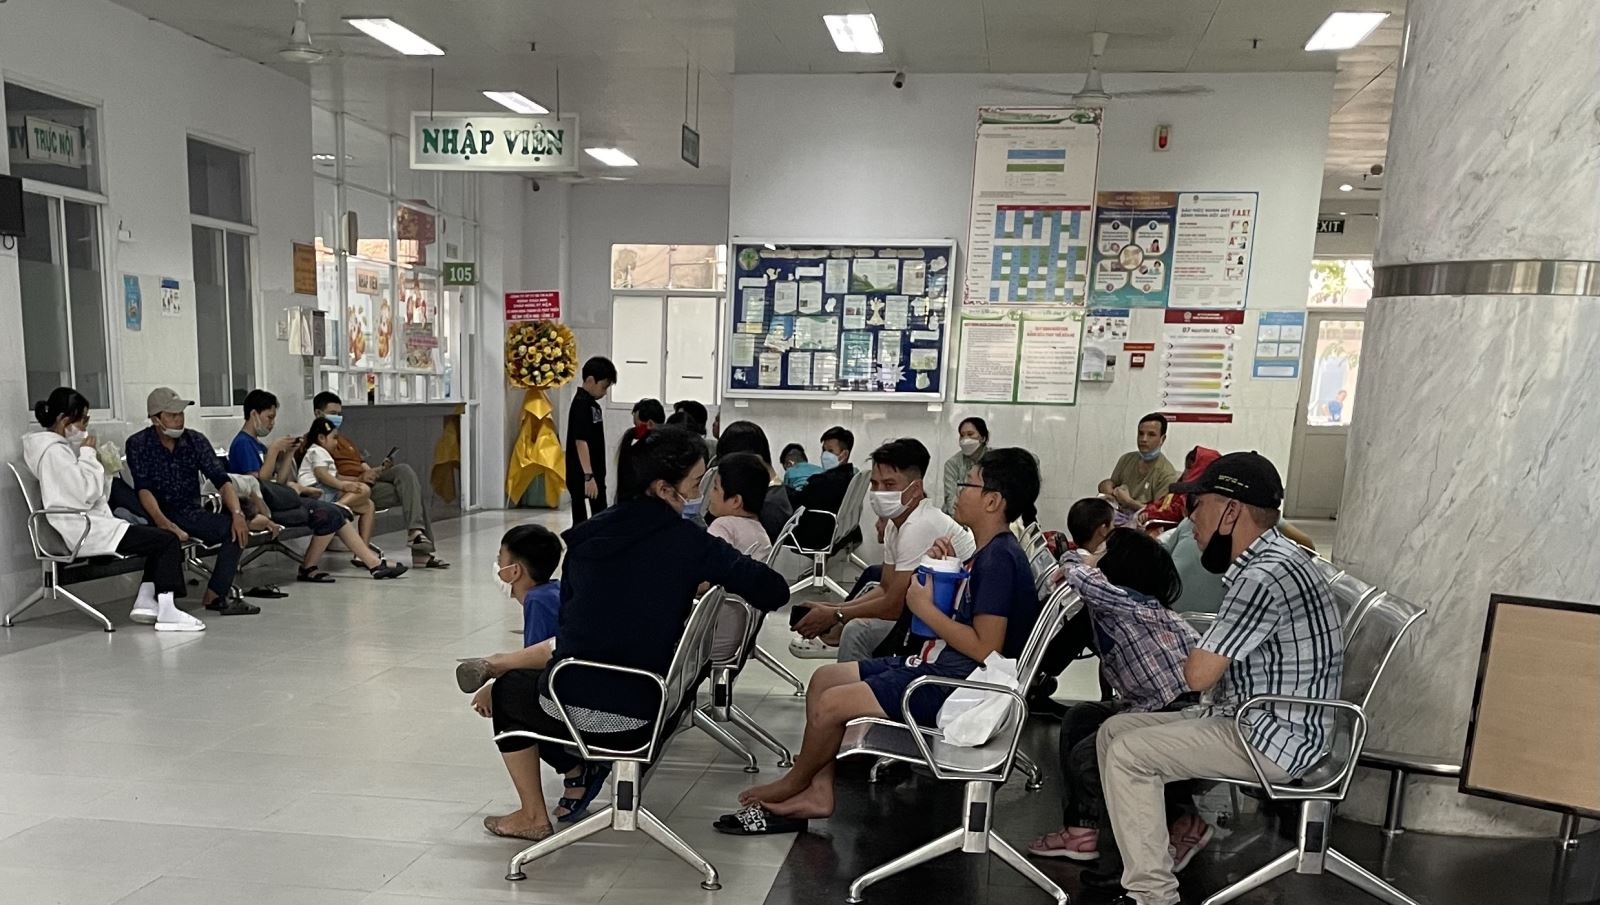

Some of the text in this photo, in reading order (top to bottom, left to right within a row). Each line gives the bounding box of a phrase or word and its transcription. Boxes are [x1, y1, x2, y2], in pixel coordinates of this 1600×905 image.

[422, 122, 564, 162] NHẬP VIỆN
[1318, 220, 1341, 232] XIT
[450, 267, 472, 282] 105
